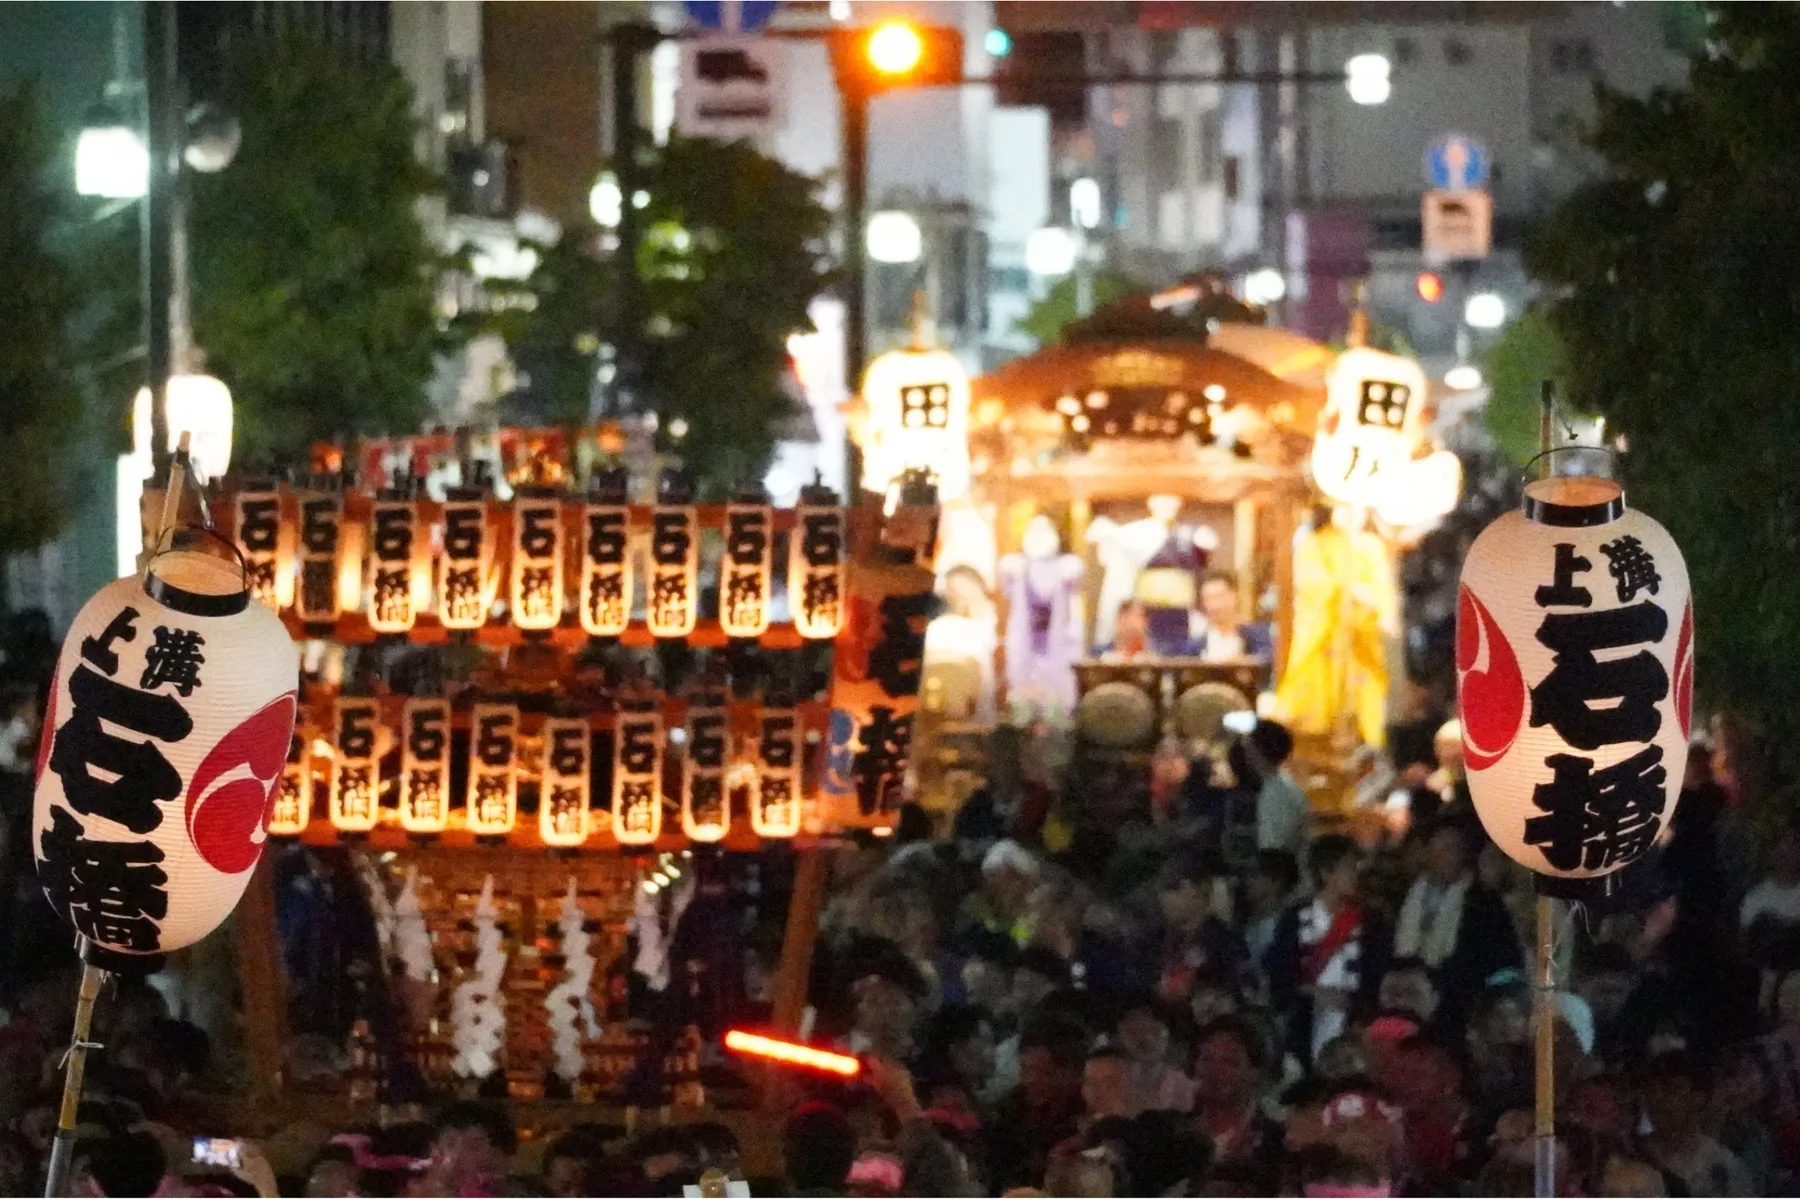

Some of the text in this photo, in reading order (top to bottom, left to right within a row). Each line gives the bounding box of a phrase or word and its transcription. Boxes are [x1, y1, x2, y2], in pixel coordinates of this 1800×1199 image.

[81, 605, 206, 697] 上溝
[1534, 534, 1662, 607] 上溝
[39, 663, 193, 946] 石橋
[1524, 600, 1669, 871] 石橋
